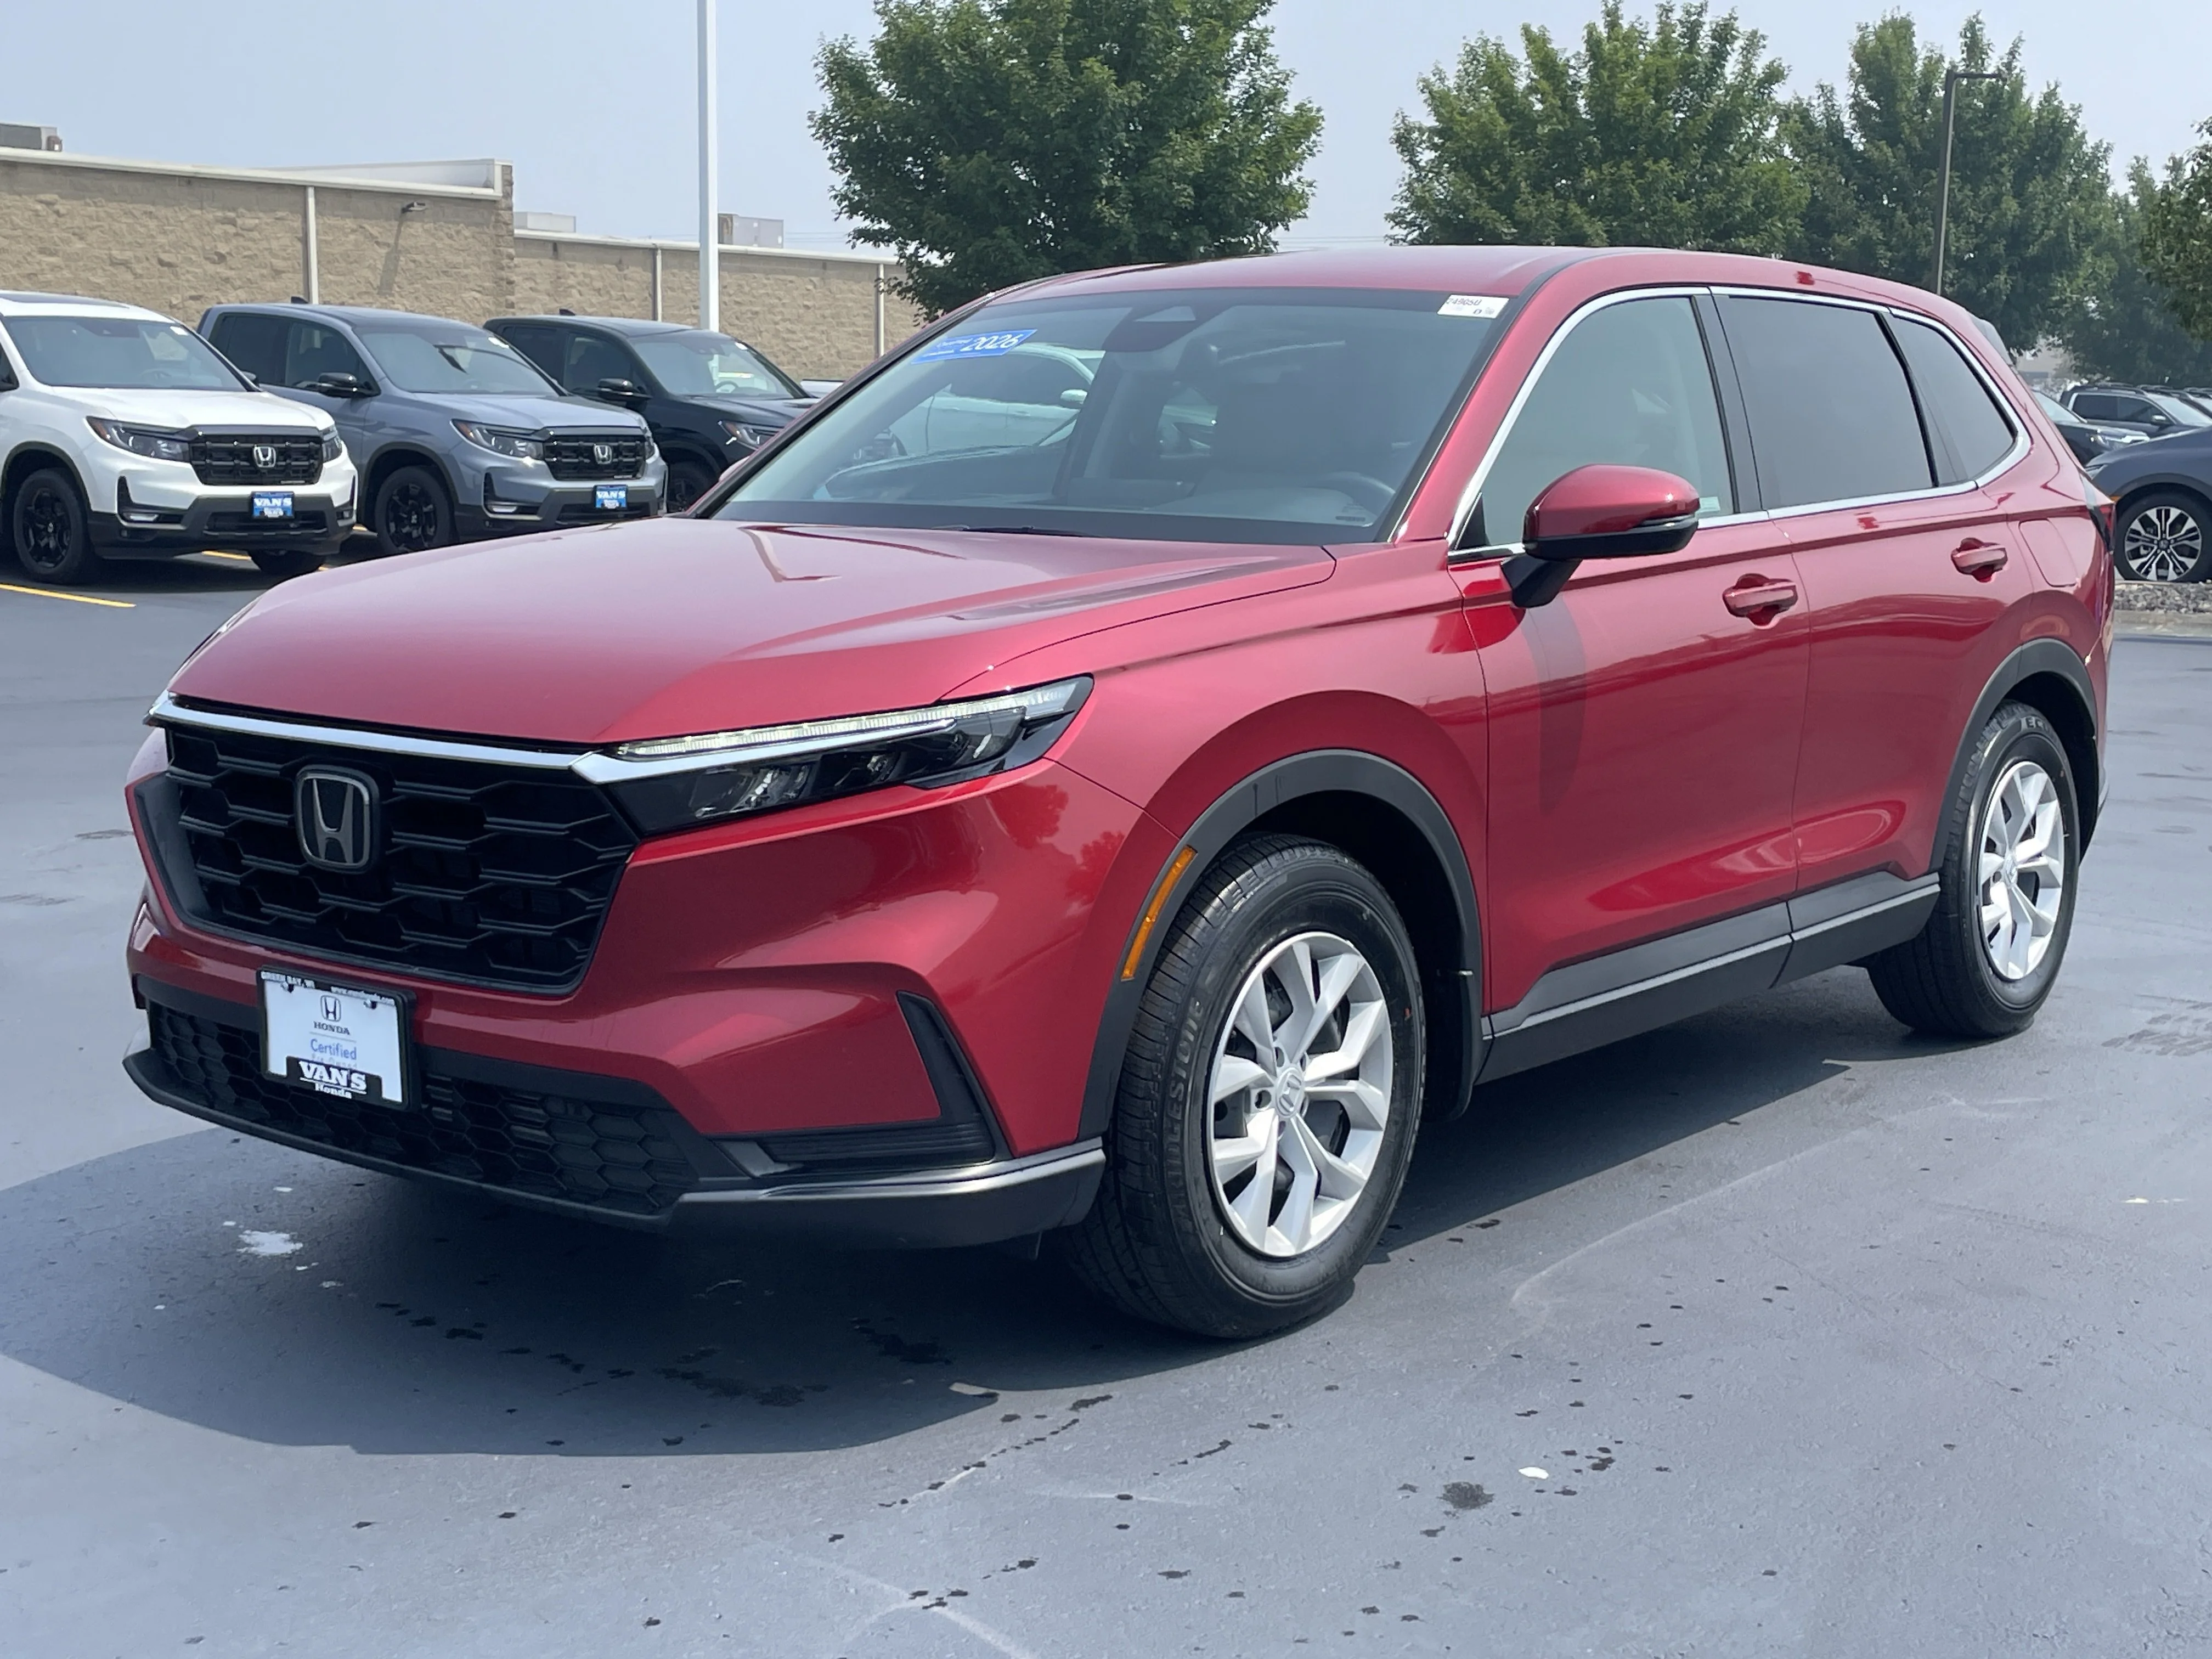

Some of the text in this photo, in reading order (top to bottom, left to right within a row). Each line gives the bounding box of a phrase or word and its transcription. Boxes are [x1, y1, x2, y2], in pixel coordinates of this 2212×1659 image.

[313, 1021, 351, 1035] HONDA
[311, 1039, 357, 1060] Certified
[315, 1082, 352, 1099] Honda
